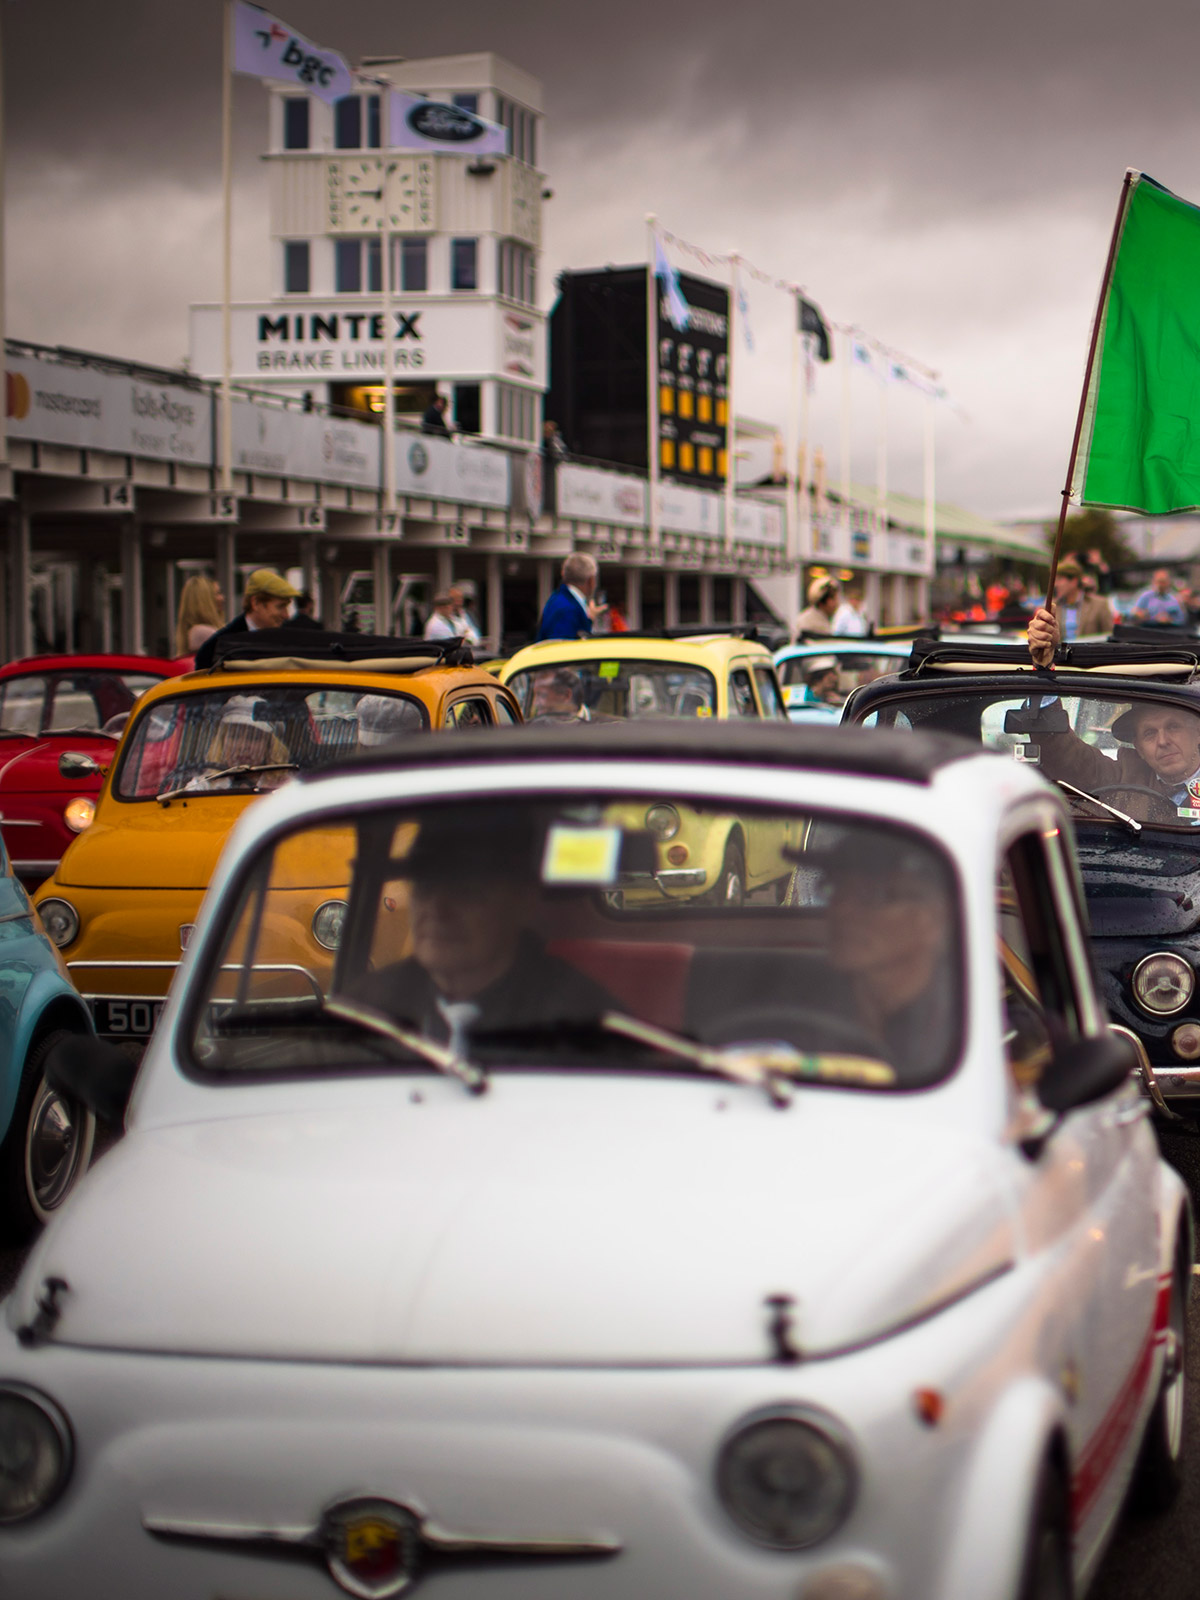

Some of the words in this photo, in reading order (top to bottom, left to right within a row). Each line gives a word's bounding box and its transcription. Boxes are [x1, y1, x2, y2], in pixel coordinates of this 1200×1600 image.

[282, 41, 335, 86] bgc
[257, 311, 423, 342] MINTEX
[257, 350, 335, 369] BRAKE
[104, 486, 128, 505] 14
[301, 510, 320, 525] 16
